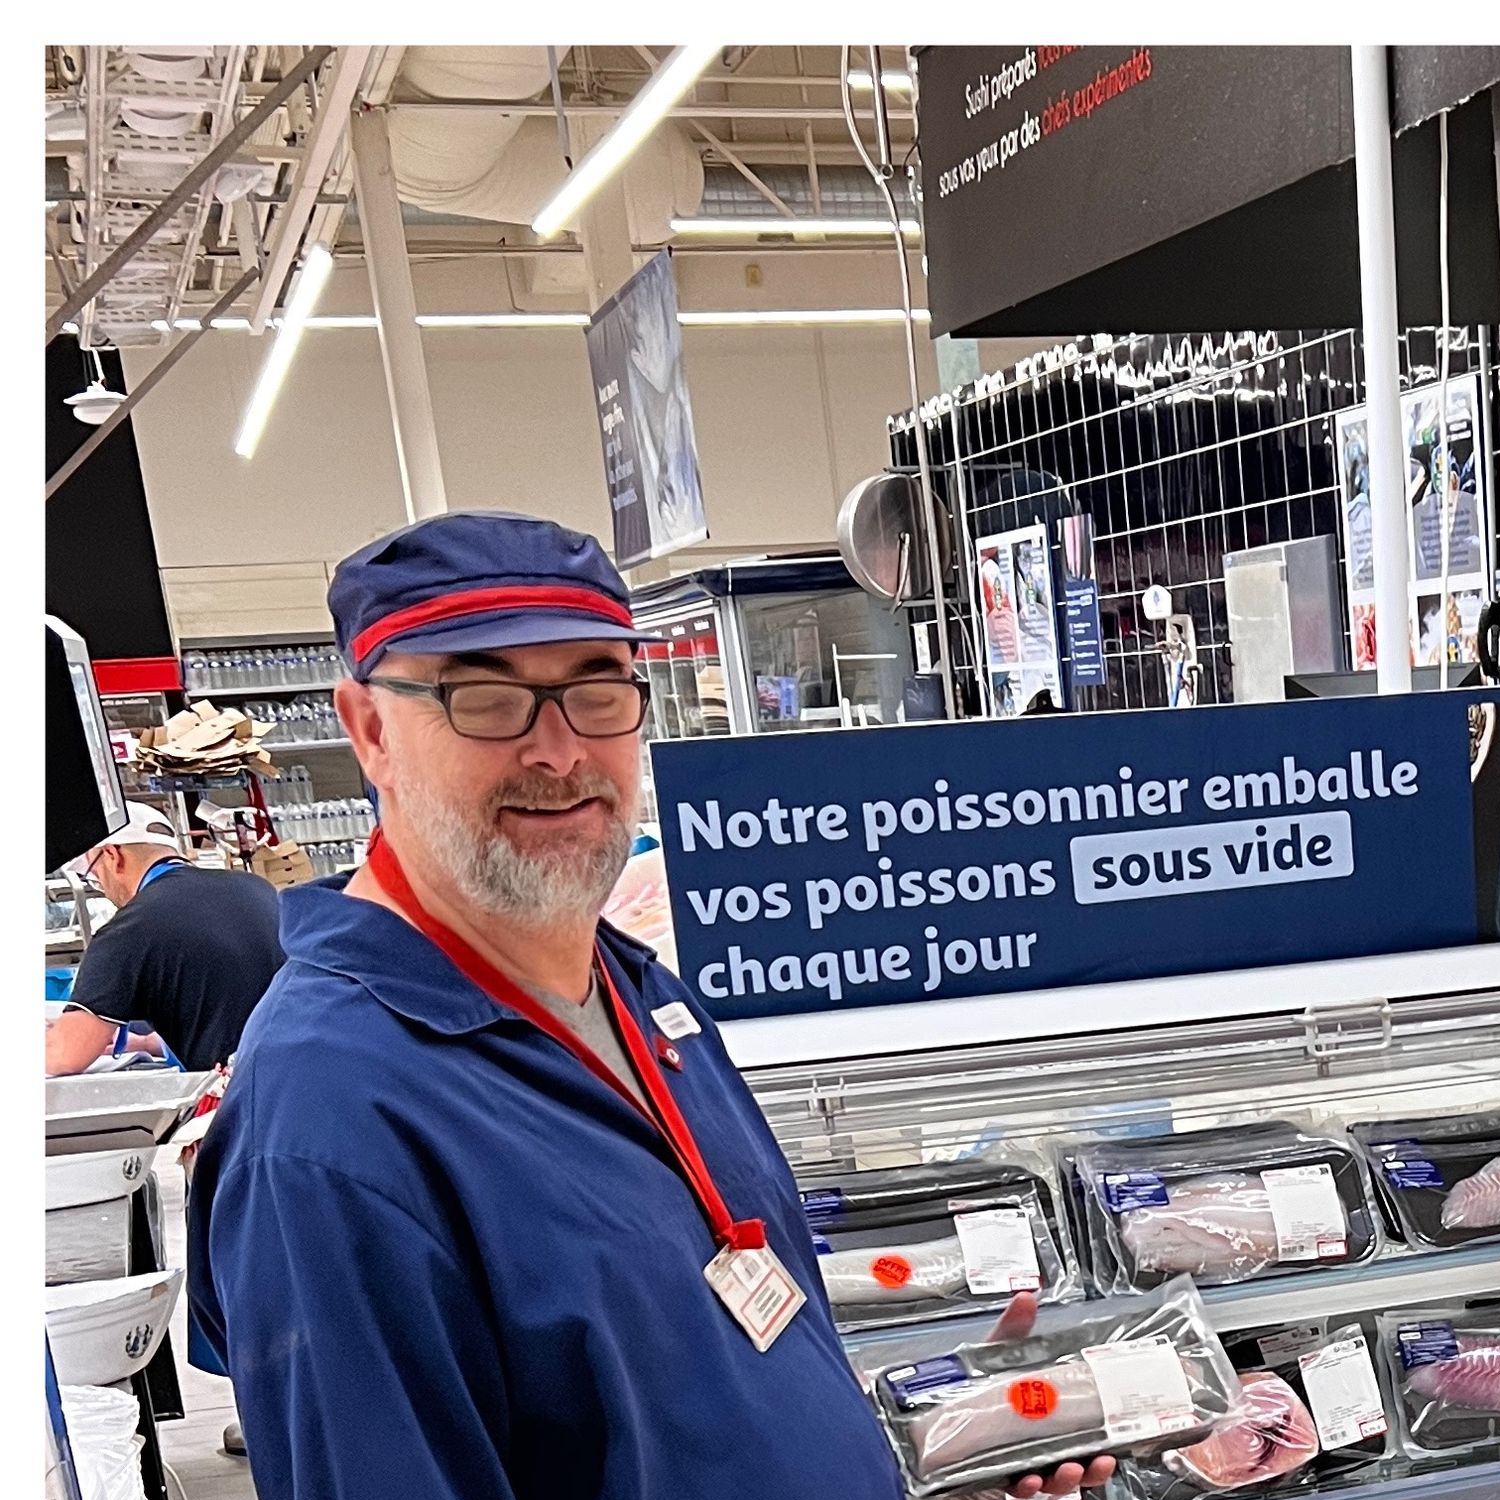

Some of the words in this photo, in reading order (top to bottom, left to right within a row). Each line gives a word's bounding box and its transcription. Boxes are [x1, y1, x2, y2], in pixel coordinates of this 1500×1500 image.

[939, 167, 958, 198] sous
[958, 157, 975, 185] vos
[976, 141, 999, 183] yeux
[1000, 127, 1019, 168] par
[1020, 110, 1040, 149] des
[1041, 89, 1071, 136] chefs
[1073, 46, 1152, 118] expérimentés
[965, 74, 989, 118] Sushi
[991, 47, 1036, 109] préparés
[678, 799, 848, 851] Notre
[863, 767, 1188, 851] poissonnier
[1203, 750, 1418, 810] emballe
[687, 883, 791, 924] vos
[806, 857, 1055, 929] poissons
[1093, 847, 1211, 889] sous
[1224, 823, 1332, 874] vide
[699, 946, 911, 1000] chaque
[924, 926, 1036, 991] jour
